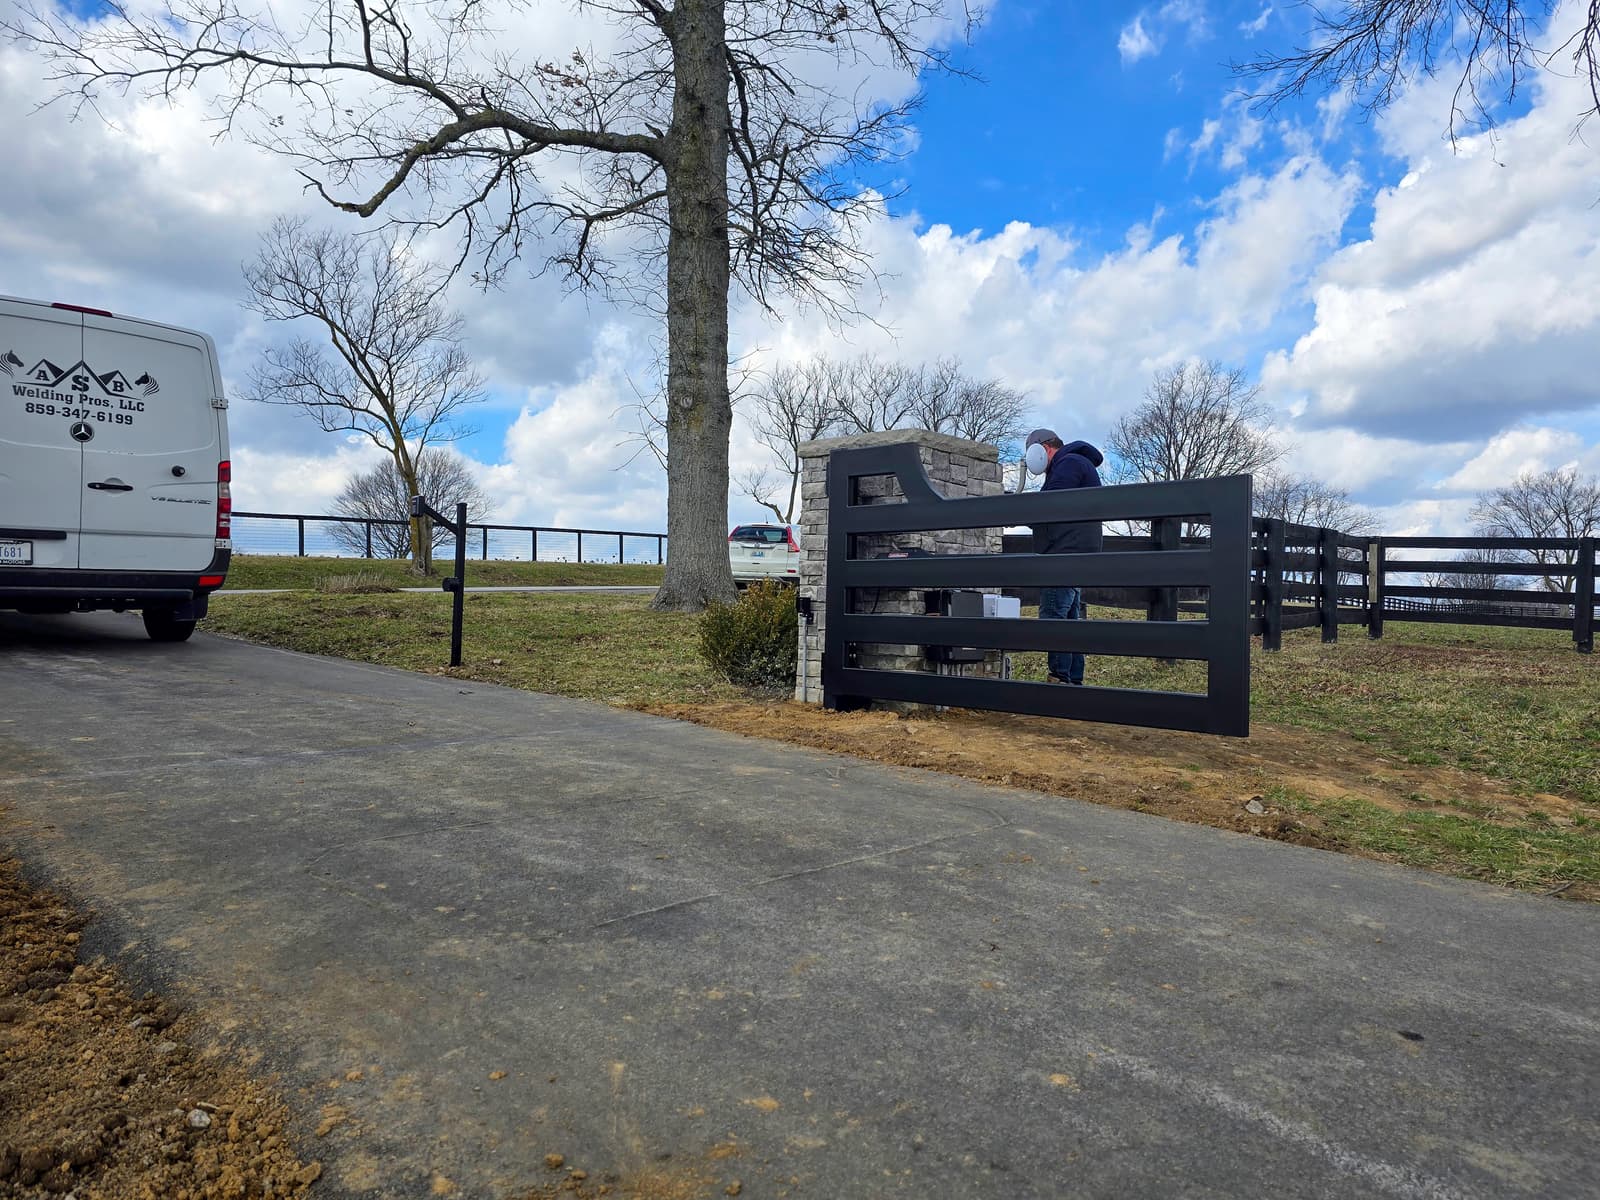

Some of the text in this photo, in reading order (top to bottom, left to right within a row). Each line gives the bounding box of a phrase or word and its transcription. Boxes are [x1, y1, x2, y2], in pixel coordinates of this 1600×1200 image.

[35, 369, 124, 392] A S B
[12, 385, 144, 412] Welding Pros, LLC
[25, 402, 133, 425] 859-347-6199
